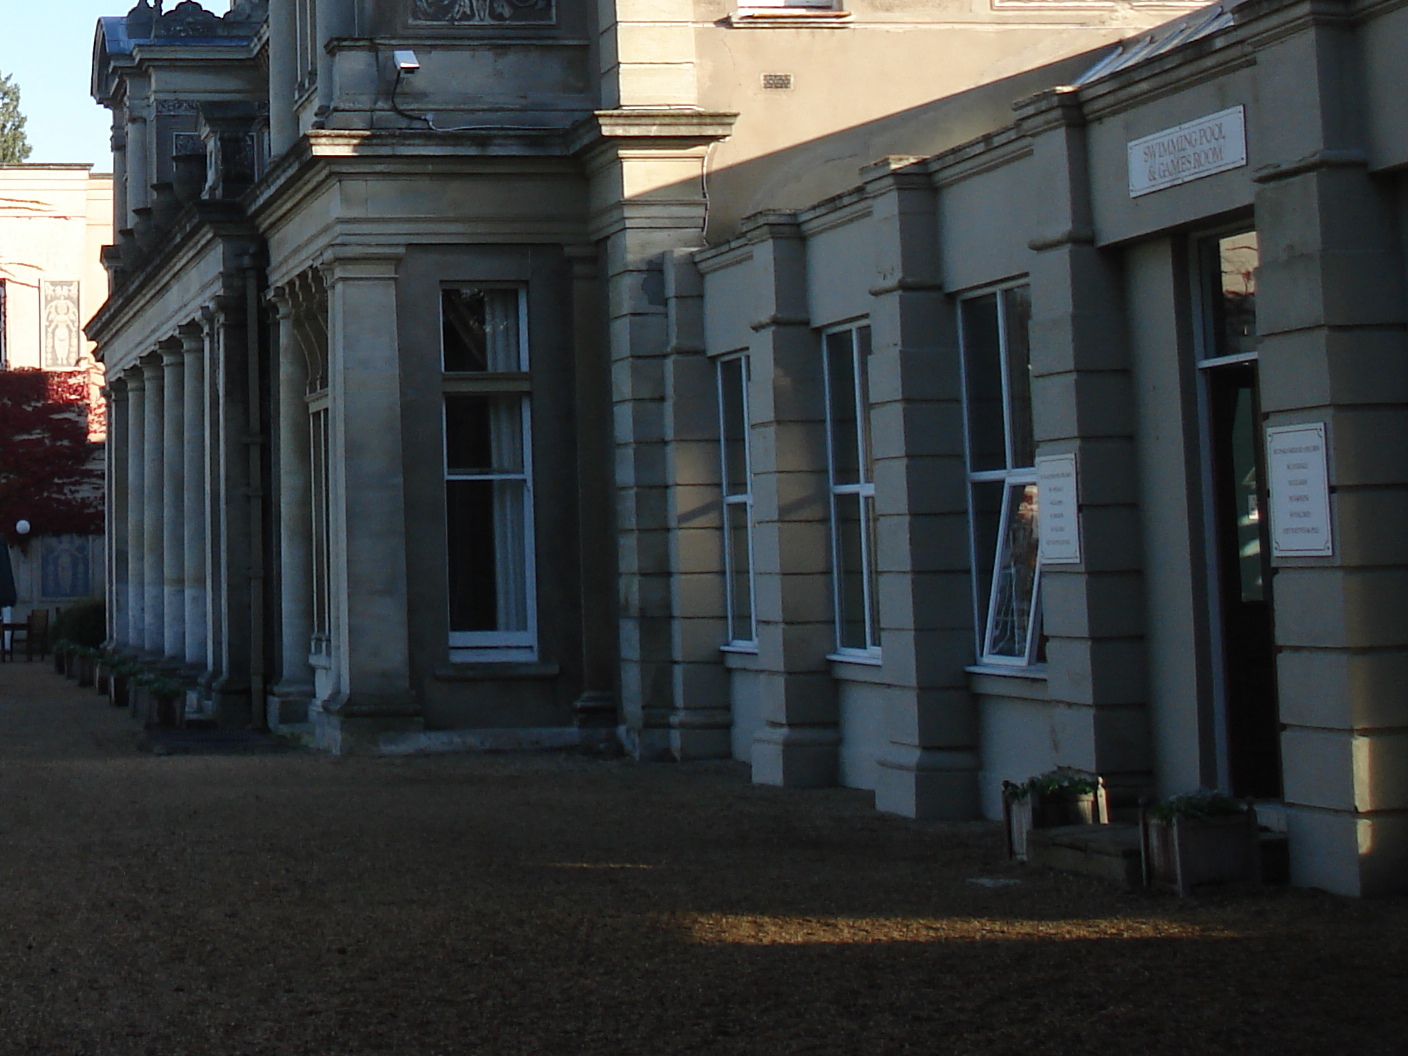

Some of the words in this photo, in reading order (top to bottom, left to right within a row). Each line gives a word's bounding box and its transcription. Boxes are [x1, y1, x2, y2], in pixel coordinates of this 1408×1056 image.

[1143, 131, 1197, 163] SWIMMING
[1198, 122, 1226, 146] POOL
[1148, 165, 1157, 182] &
[1158, 155, 1192, 178] GAMES
[1193, 144, 1224, 169] ROOM
